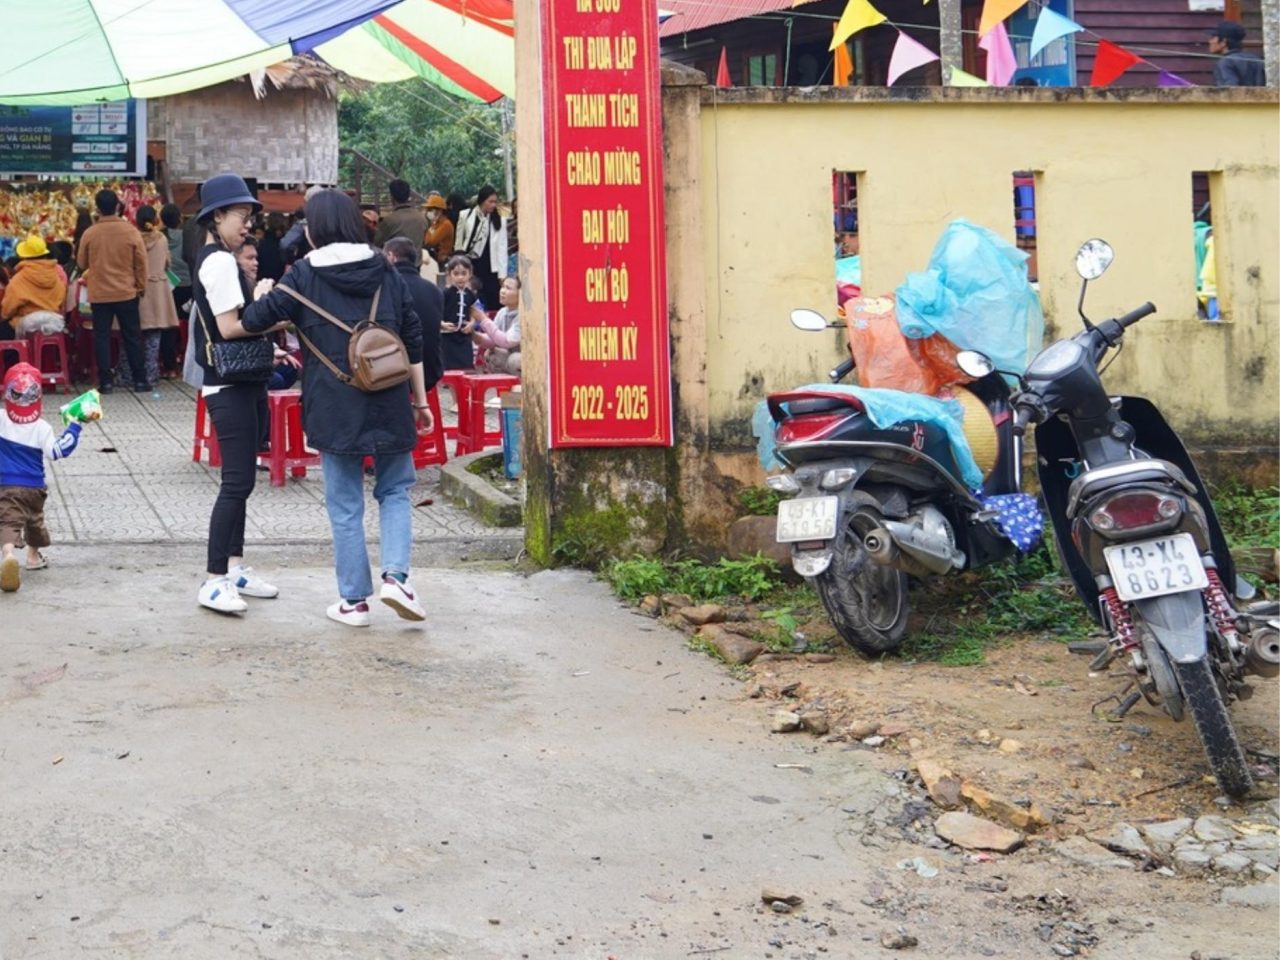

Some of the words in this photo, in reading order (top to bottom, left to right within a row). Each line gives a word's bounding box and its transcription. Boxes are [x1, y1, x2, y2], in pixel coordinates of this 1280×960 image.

[563, 36, 584, 70] THI
[587, 36, 612, 70] ĐUA
[614, 30, 637, 76] LẬP
[565, 88, 607, 127] THÀNH
[609, 88, 639, 128] TÍCH
[567, 146, 600, 186] CHÀO
[604, 146, 641, 186] MỪNG
[582, 209, 604, 251] ĐẠI
[607, 203, 629, 251] HỘI
[586, 268, 608, 303] CHI
[611, 262, 629, 309] BỘ
[579, 320, 619, 368] NHIỆM
[622, 321, 638, 360] KỲ
[572, 385, 604, 420] 2022
[616, 385, 649, 420] 2025
[1120, 539, 1185, 570] 43-X4
[1127, 564, 1193, 594] 8623
